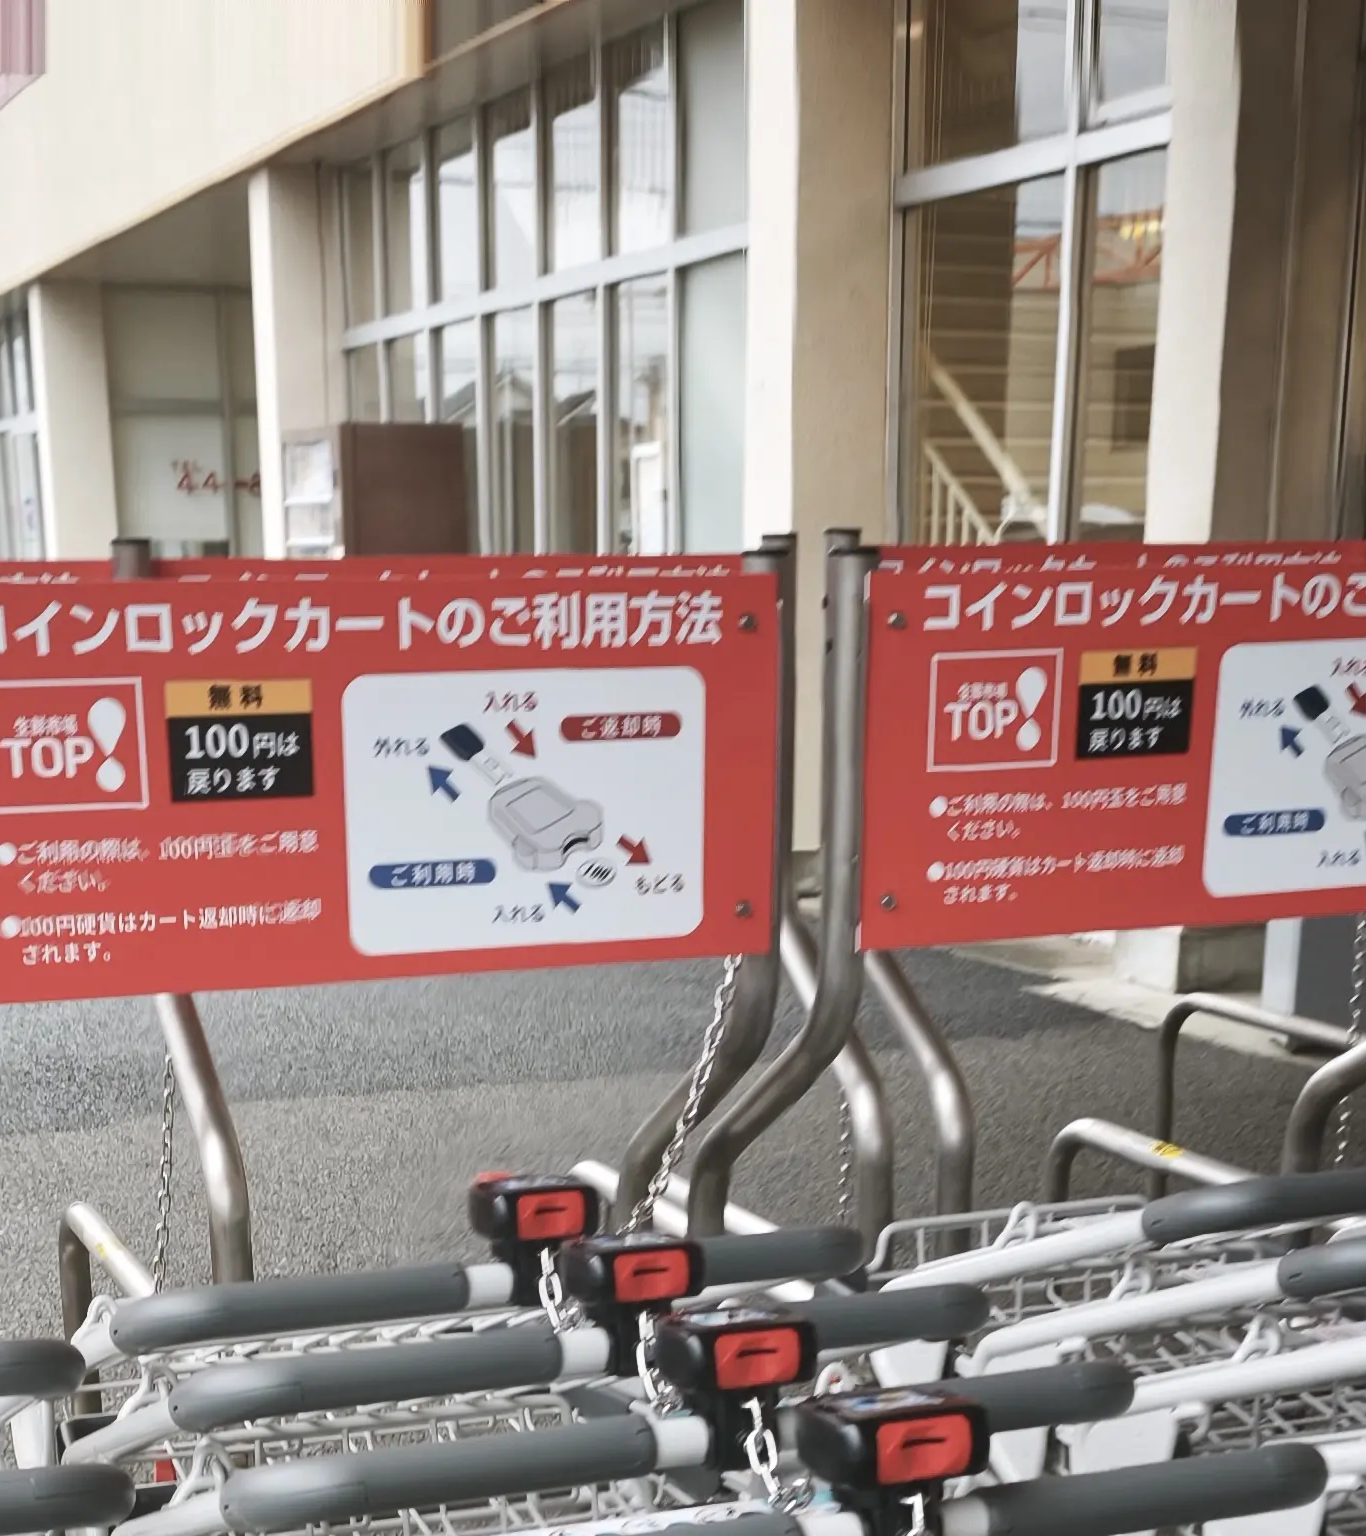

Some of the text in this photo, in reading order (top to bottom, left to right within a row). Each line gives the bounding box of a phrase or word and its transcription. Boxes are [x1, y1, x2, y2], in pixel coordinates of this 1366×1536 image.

[208, 684, 263, 710] 無料
[482, 690, 538, 713] 入れる
[1089, 688, 1184, 721] 100円は
[185, 722, 300, 760] 100円は
[372, 737, 430, 758] 外れる
[184, 765, 280, 796] 戻ります
[634, 873, 685, 895] もどる
[491, 904, 545, 925] 入れる
[21, 941, 112, 966] されます。
